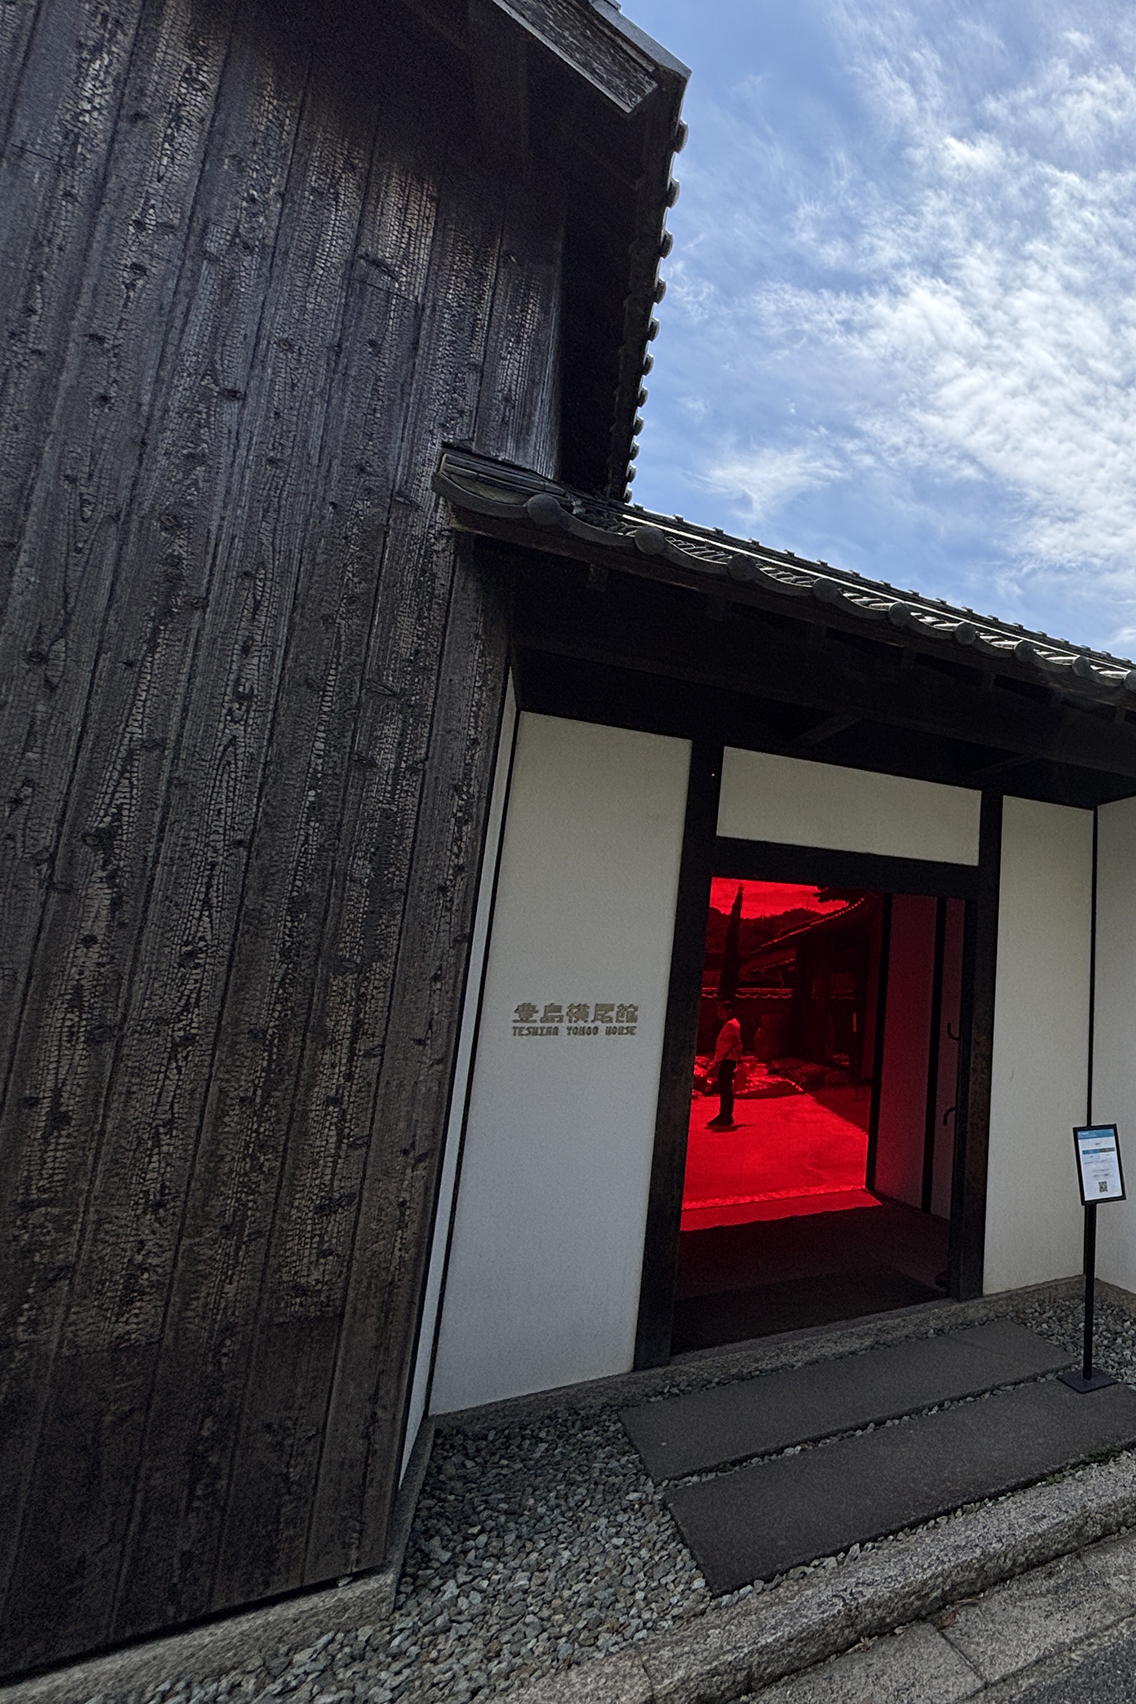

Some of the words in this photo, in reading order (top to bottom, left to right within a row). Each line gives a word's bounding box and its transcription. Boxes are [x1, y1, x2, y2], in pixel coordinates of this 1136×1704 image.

[512, 1026, 559, 1036] TESHIMA
[566, 1026, 599, 1036] YOKOO
[605, 1026, 637, 1036] HOUSE
